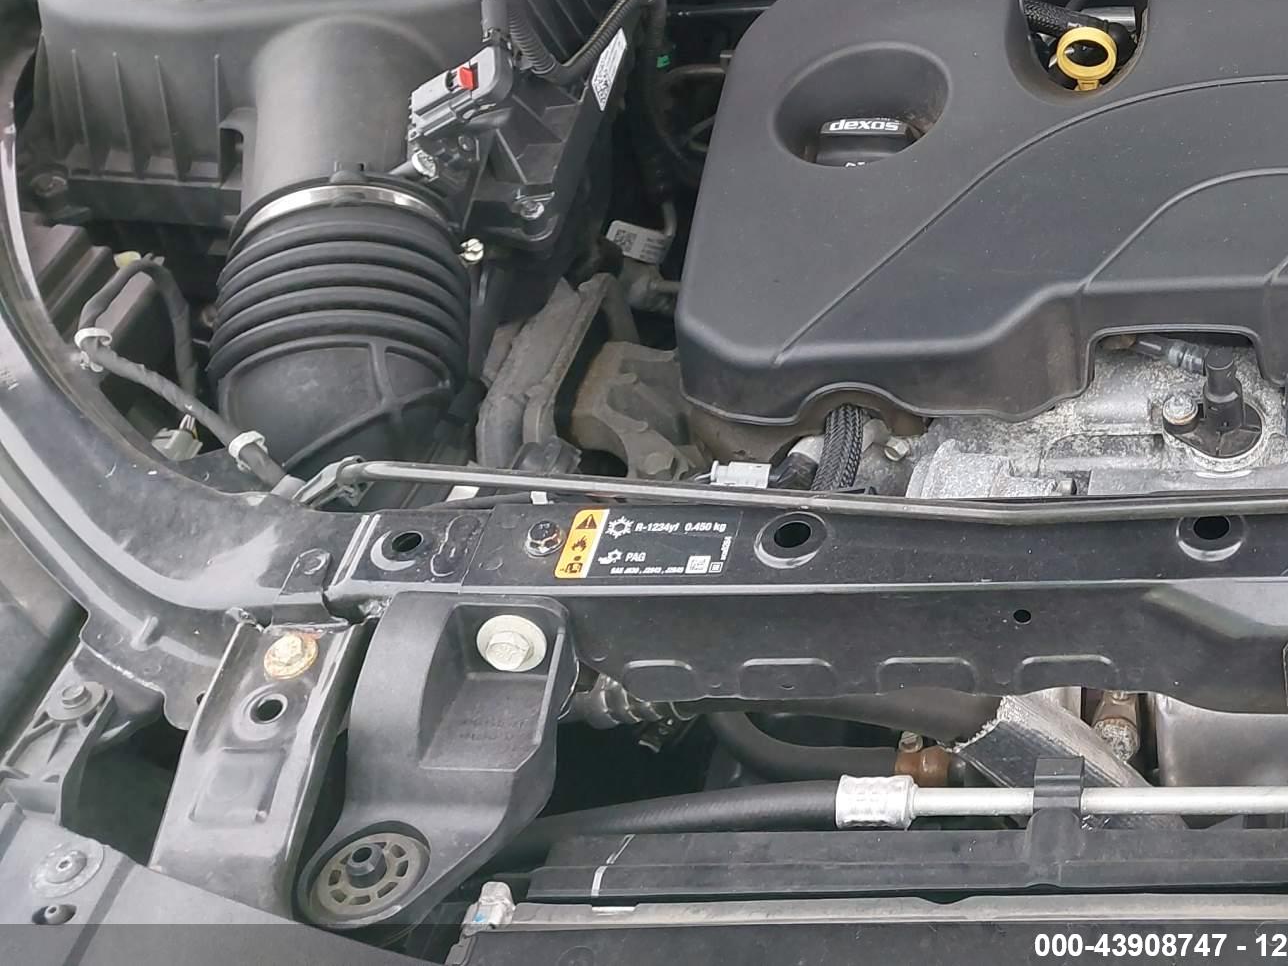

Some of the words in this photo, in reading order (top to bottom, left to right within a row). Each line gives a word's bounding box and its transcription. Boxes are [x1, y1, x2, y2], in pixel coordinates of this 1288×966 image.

[829, 119, 901, 131] dexos
[635, 522, 680, 533] R-1234yf
[684, 522, 712, 533] 0.450
[713, 522, 727, 533] kg
[625, 552, 646, 562] PAG
